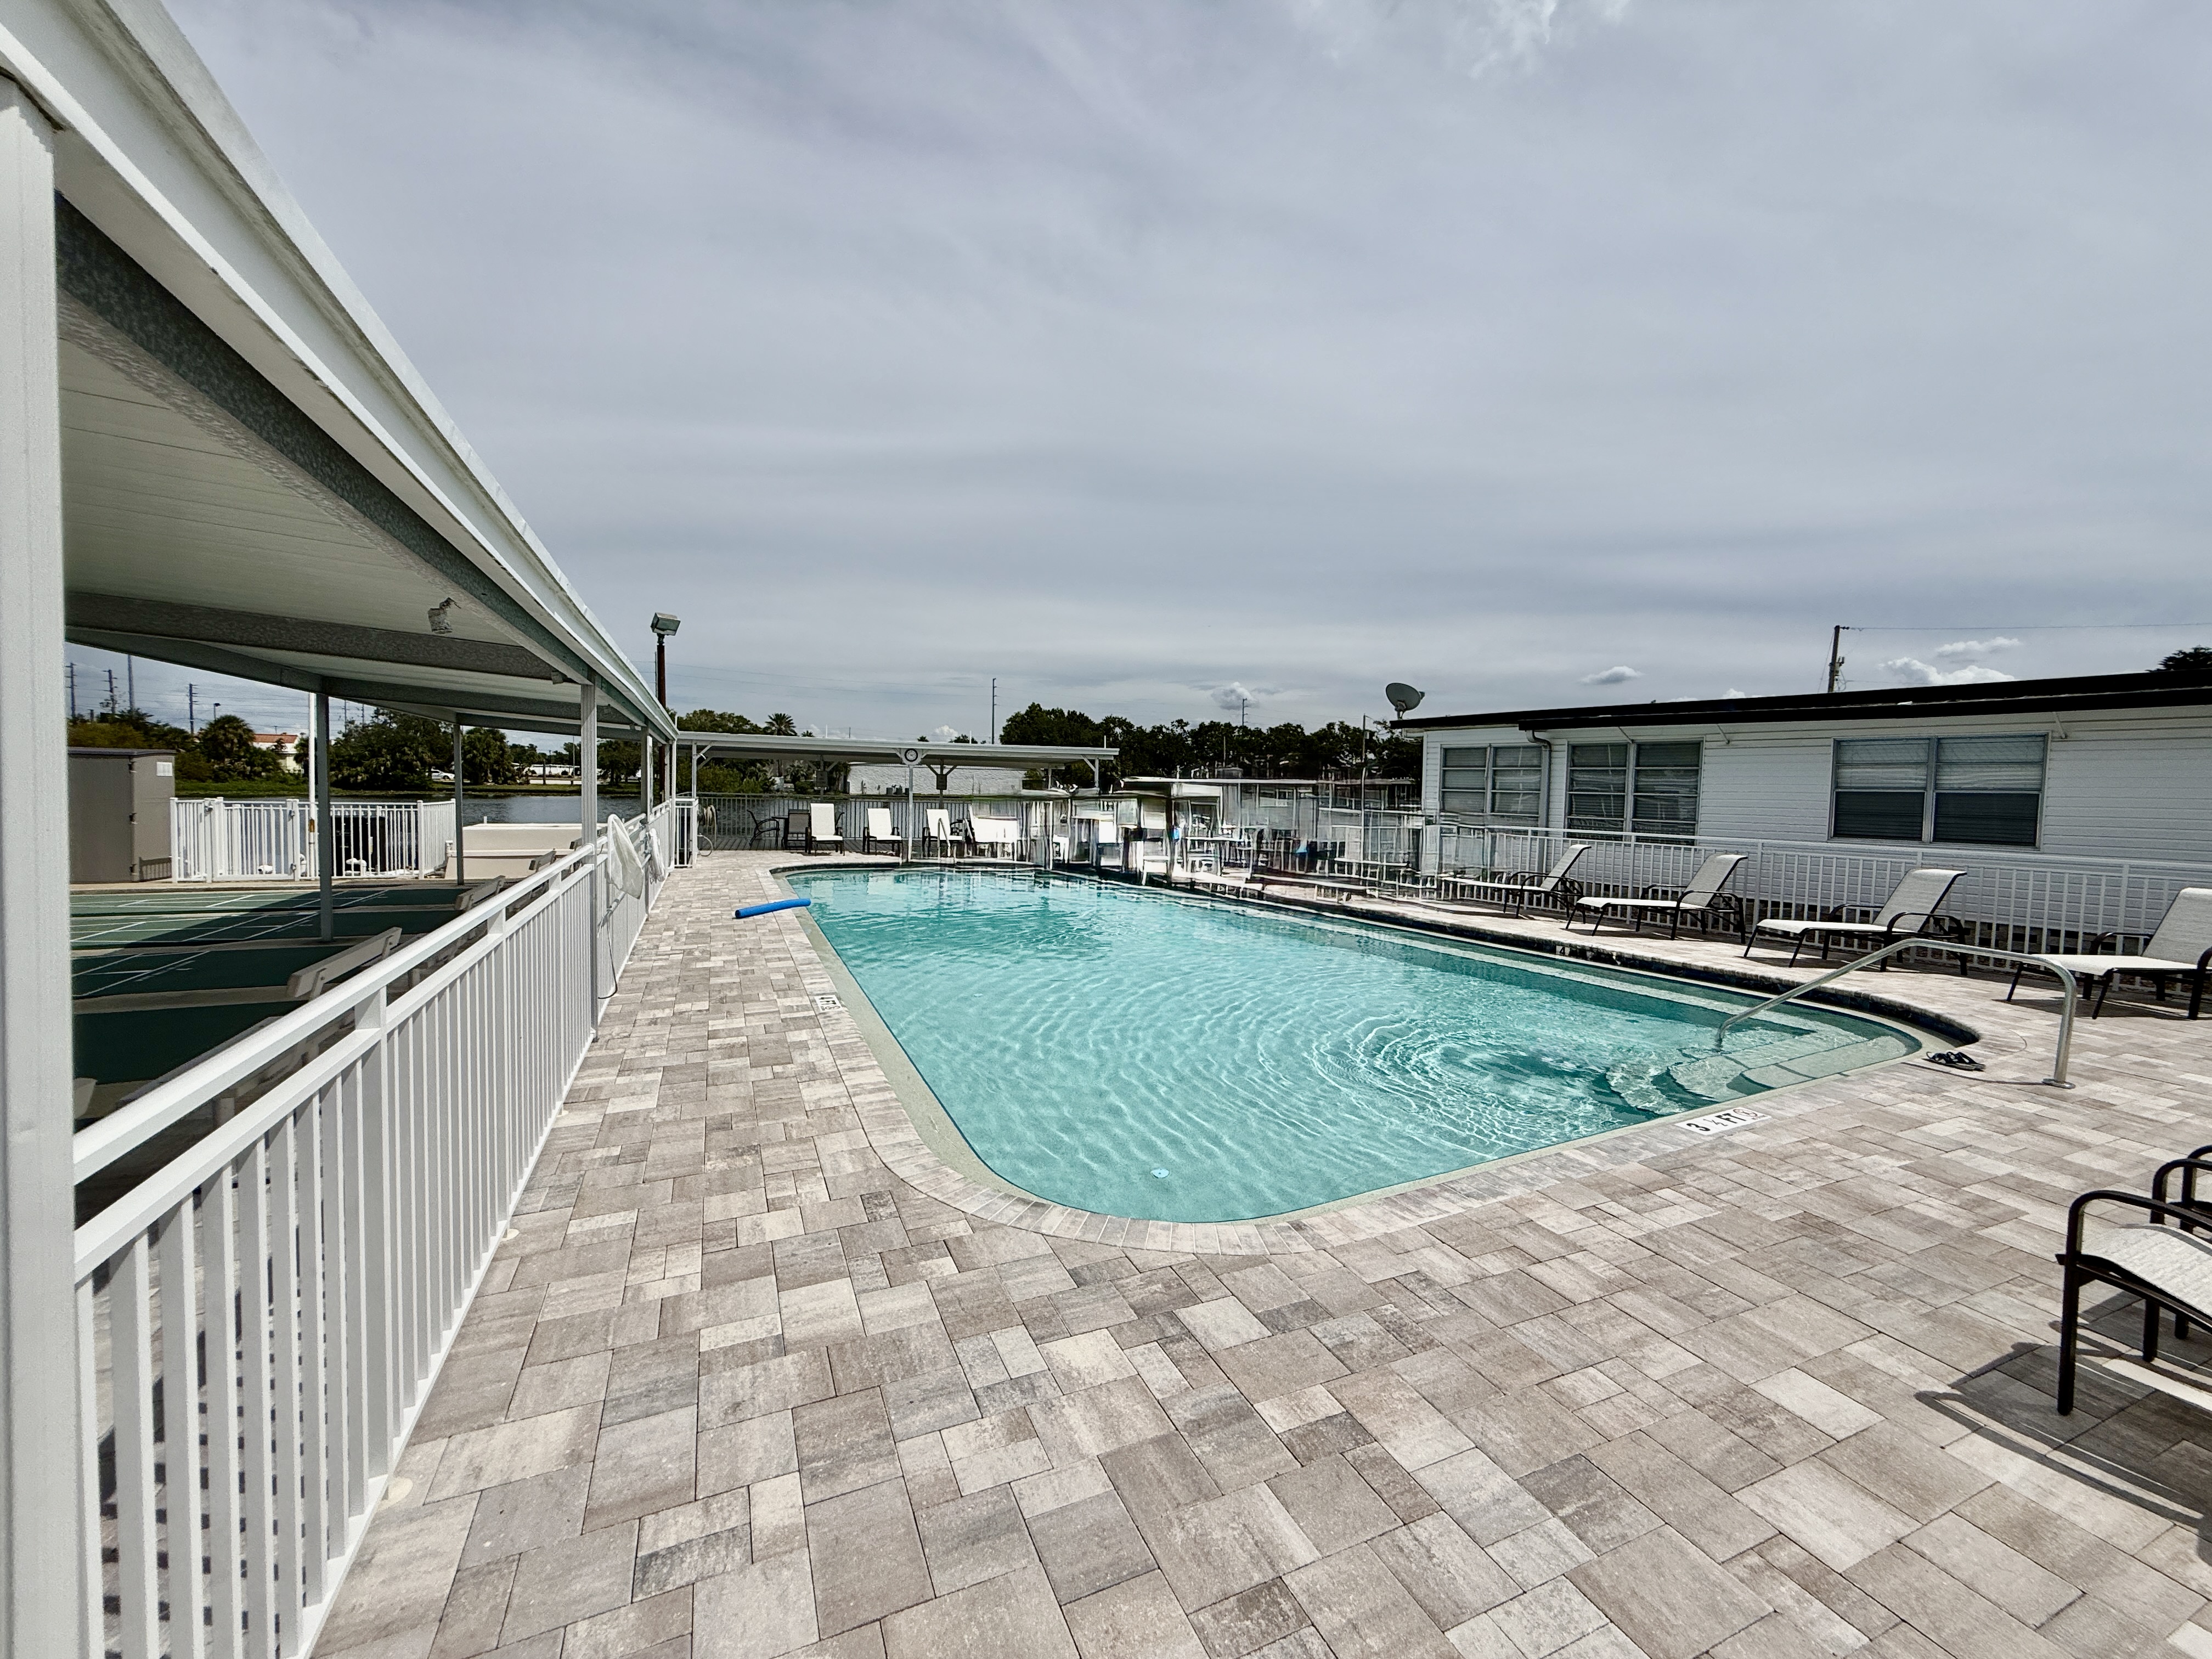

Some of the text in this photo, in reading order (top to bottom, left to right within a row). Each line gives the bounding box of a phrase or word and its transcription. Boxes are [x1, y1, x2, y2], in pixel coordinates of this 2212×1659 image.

[1559, 946, 1565, 955] 4
[1686, 1123, 1711, 1131] 3
[1715, 1113, 1747, 1124] FT
